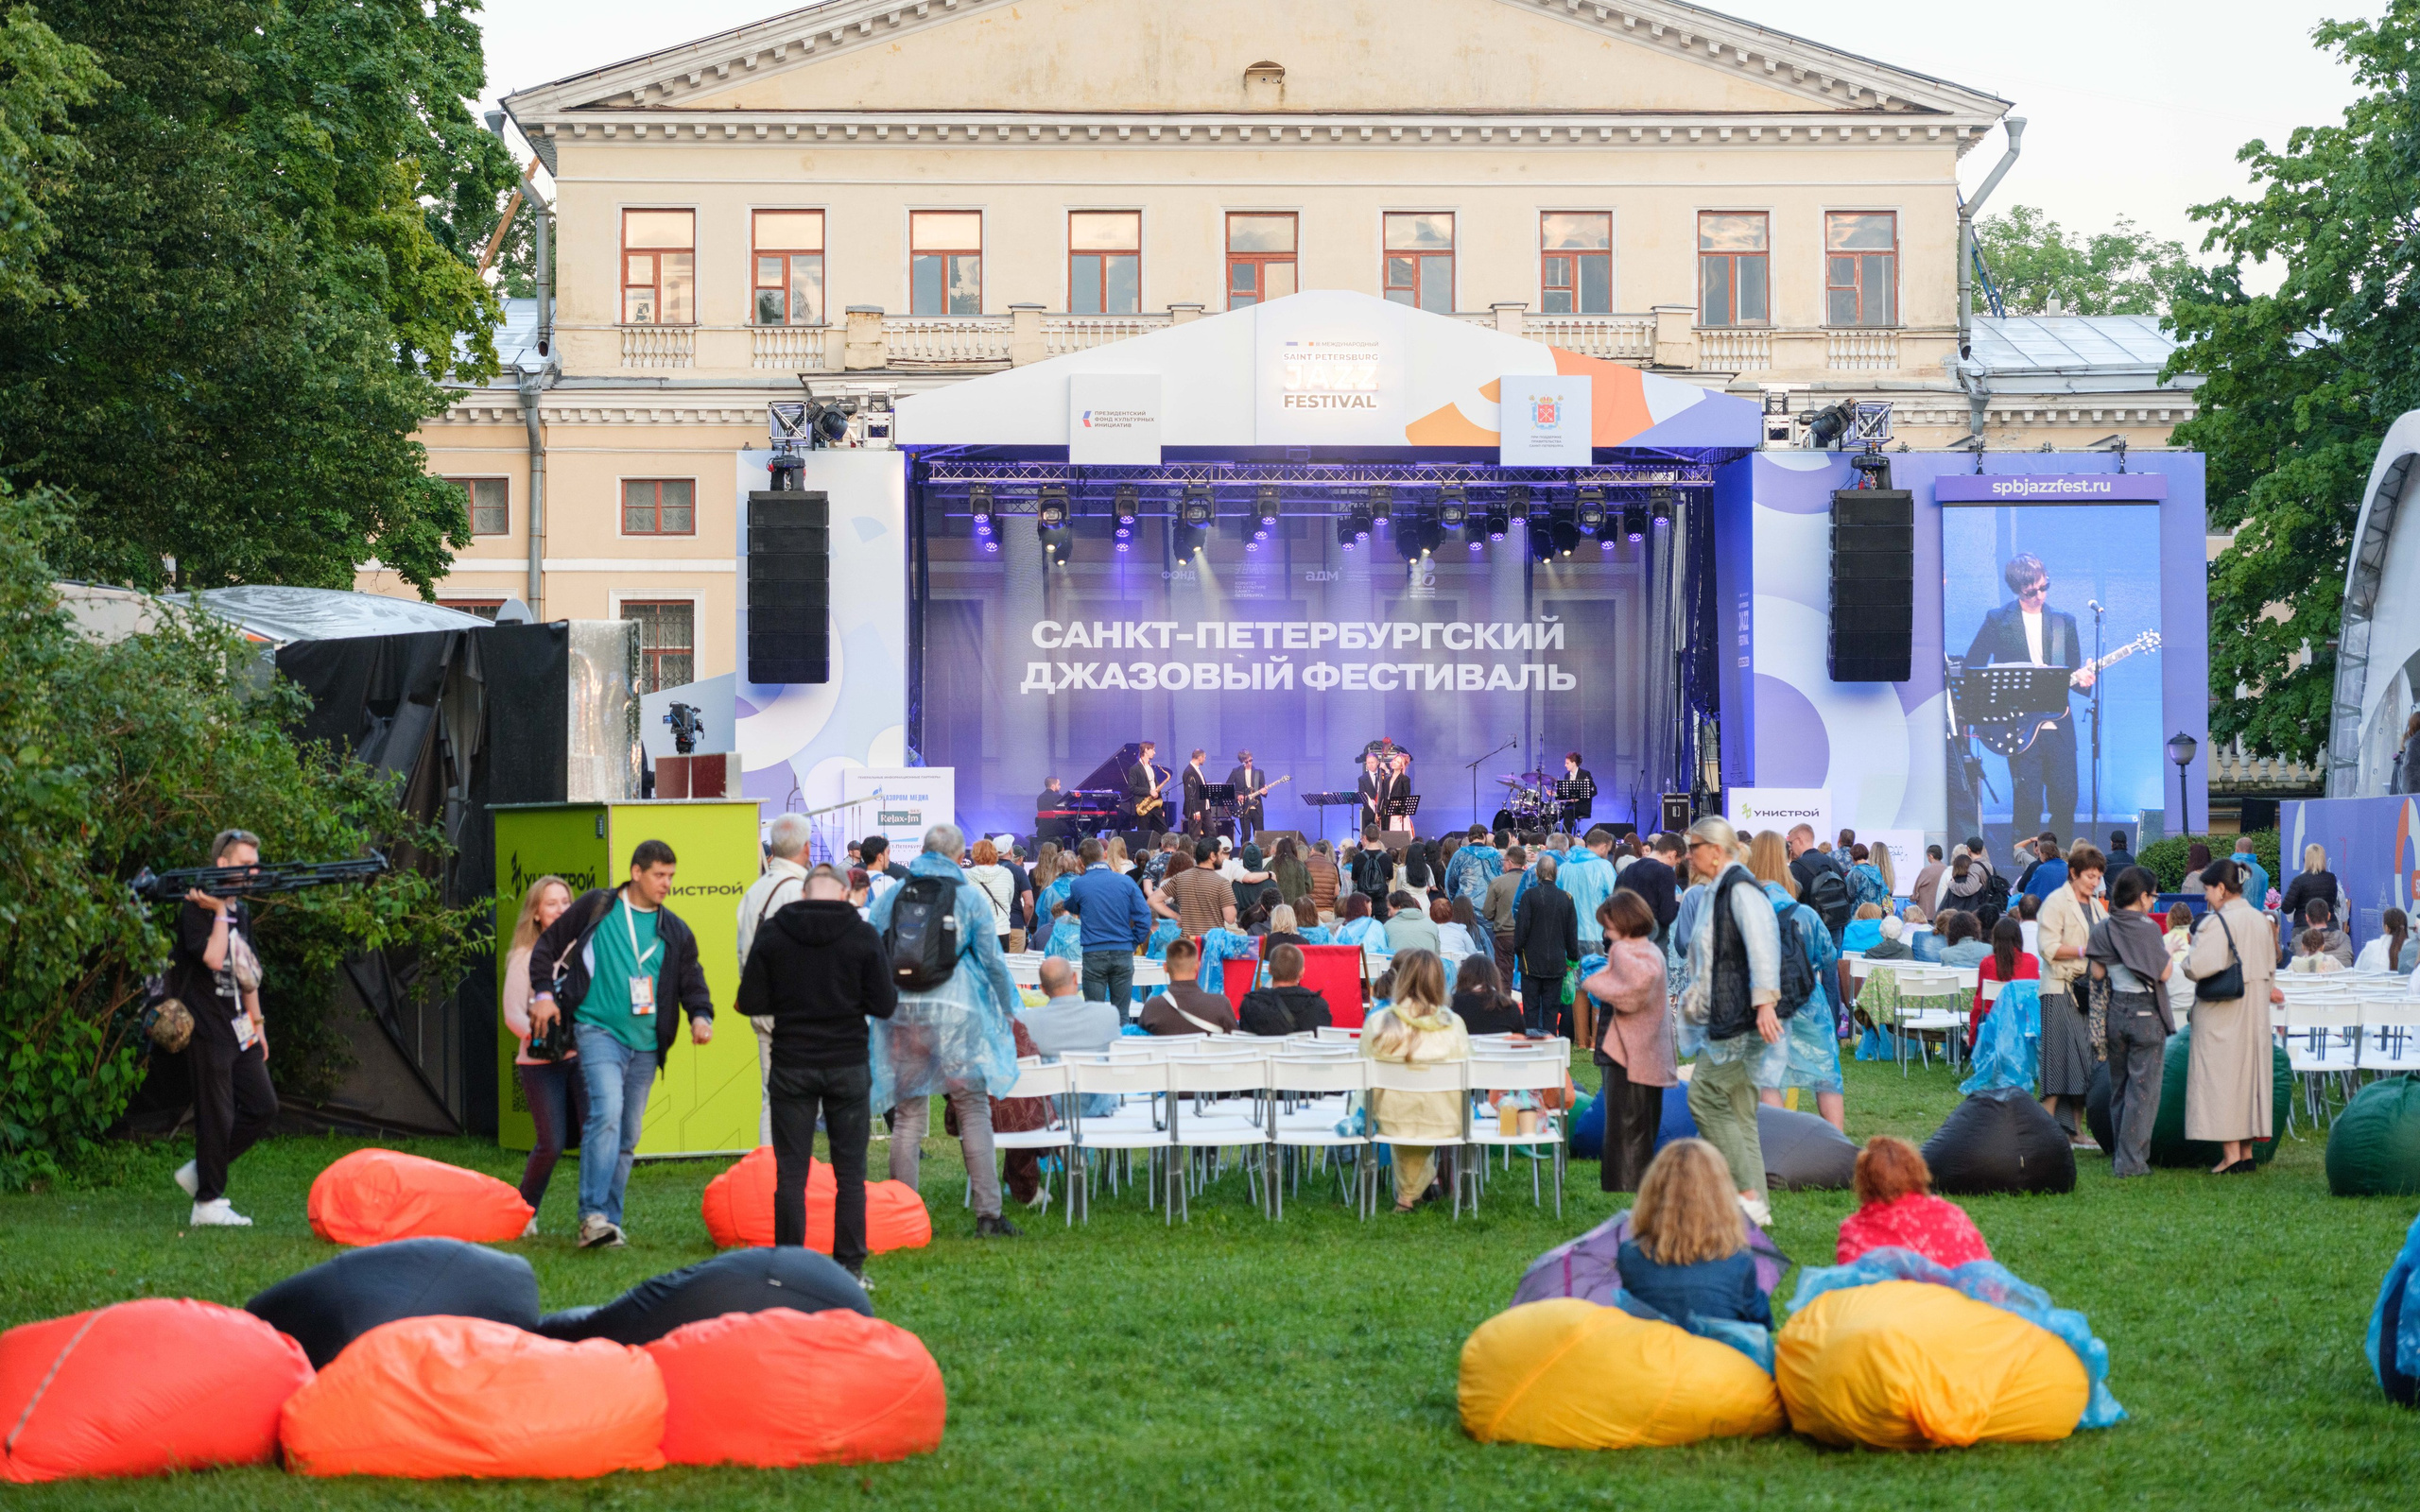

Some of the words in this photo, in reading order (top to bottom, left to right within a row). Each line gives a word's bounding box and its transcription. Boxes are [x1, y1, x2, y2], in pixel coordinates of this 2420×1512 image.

[1284, 365, 1379, 390] JAZZ
[1284, 395, 1376, 408] FESTIVAL
[1993, 479, 2111, 497] spbjazzfest.ru
[1161, 570, 1196, 581] ФОНД
[1031, 615, 1565, 650] САНКТ-ПЕТЕРБУРГСКИЙ
[1021, 656, 1294, 695] ДЖАЗОВЫЙ
[1302, 662, 1577, 692] ФЕСТИВАЛЬ
[1754, 808, 1820, 816] УНИСТРОЙ
